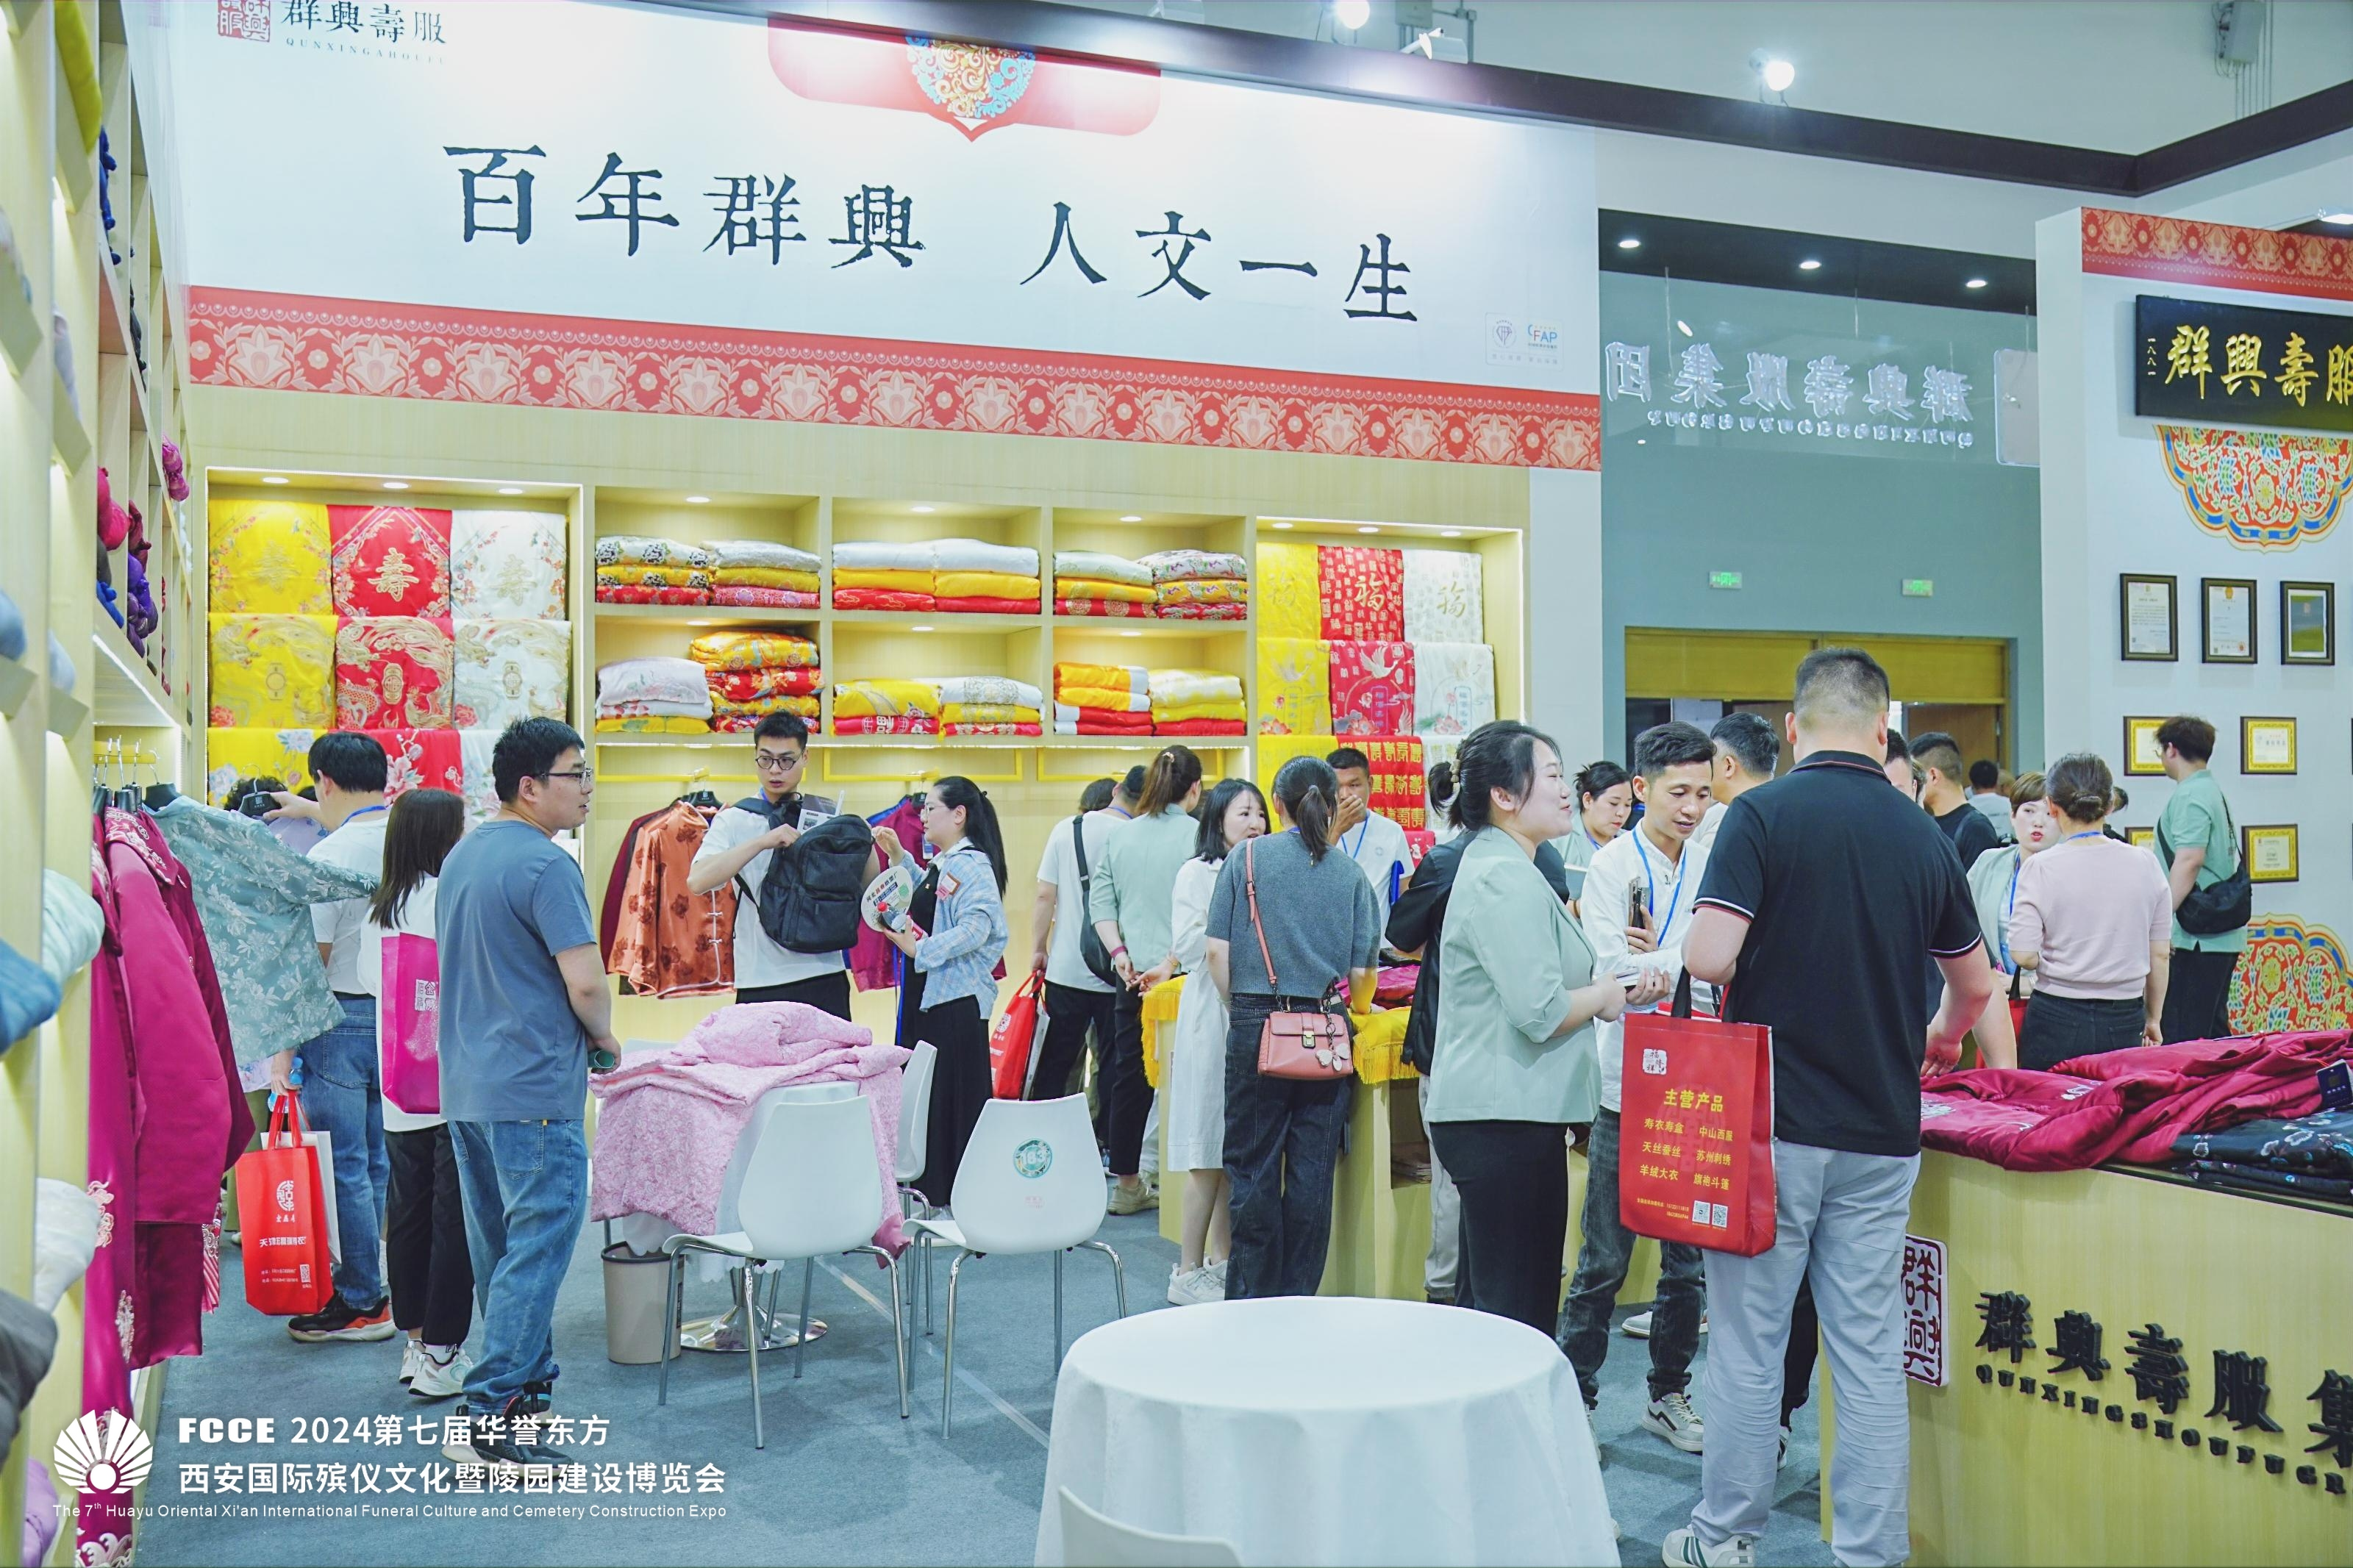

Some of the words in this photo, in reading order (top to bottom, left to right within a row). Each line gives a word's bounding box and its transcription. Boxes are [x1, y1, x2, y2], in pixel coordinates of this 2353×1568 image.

[443, 145, 926, 268] 百年群興
[1020, 201, 1418, 322] 人文一生
[1354, 572, 1385, 612] 福
[1436, 581, 1467, 617] 福
[1664, 1089, 1723, 1112] 主营产品
[1644, 1117, 1684, 1134] 寿衣寿盒
[1699, 1126, 1733, 1142] 中山西服
[1642, 1141, 1681, 1158] 天丝蚕丝
[1696, 1150, 1731, 1166] 苏州刺绣
[1640, 1164, 1679, 1181] 羊绒大衣
